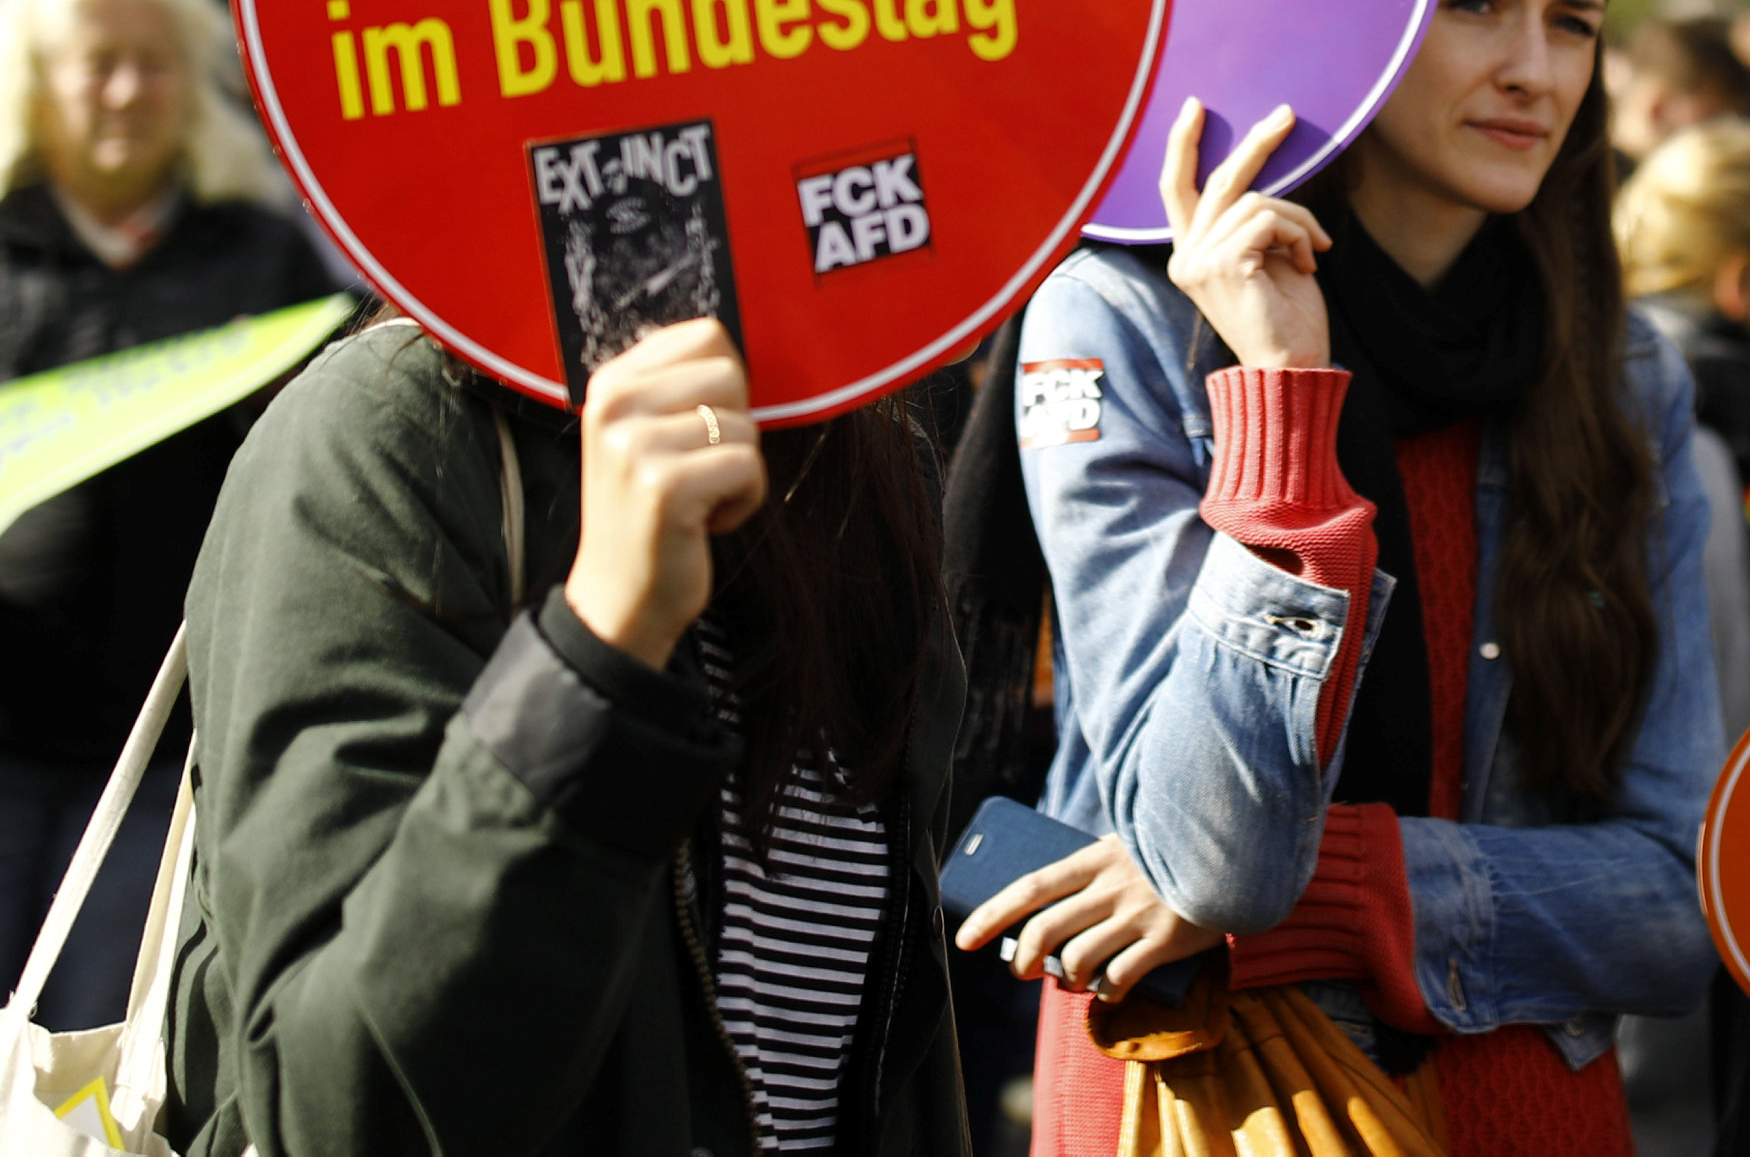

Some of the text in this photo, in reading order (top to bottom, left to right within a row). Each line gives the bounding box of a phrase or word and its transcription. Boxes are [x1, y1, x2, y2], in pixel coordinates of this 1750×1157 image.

[797, 153, 923, 226] FCK
[814, 204, 930, 273] AFD
[1022, 369, 1103, 406] FCK
